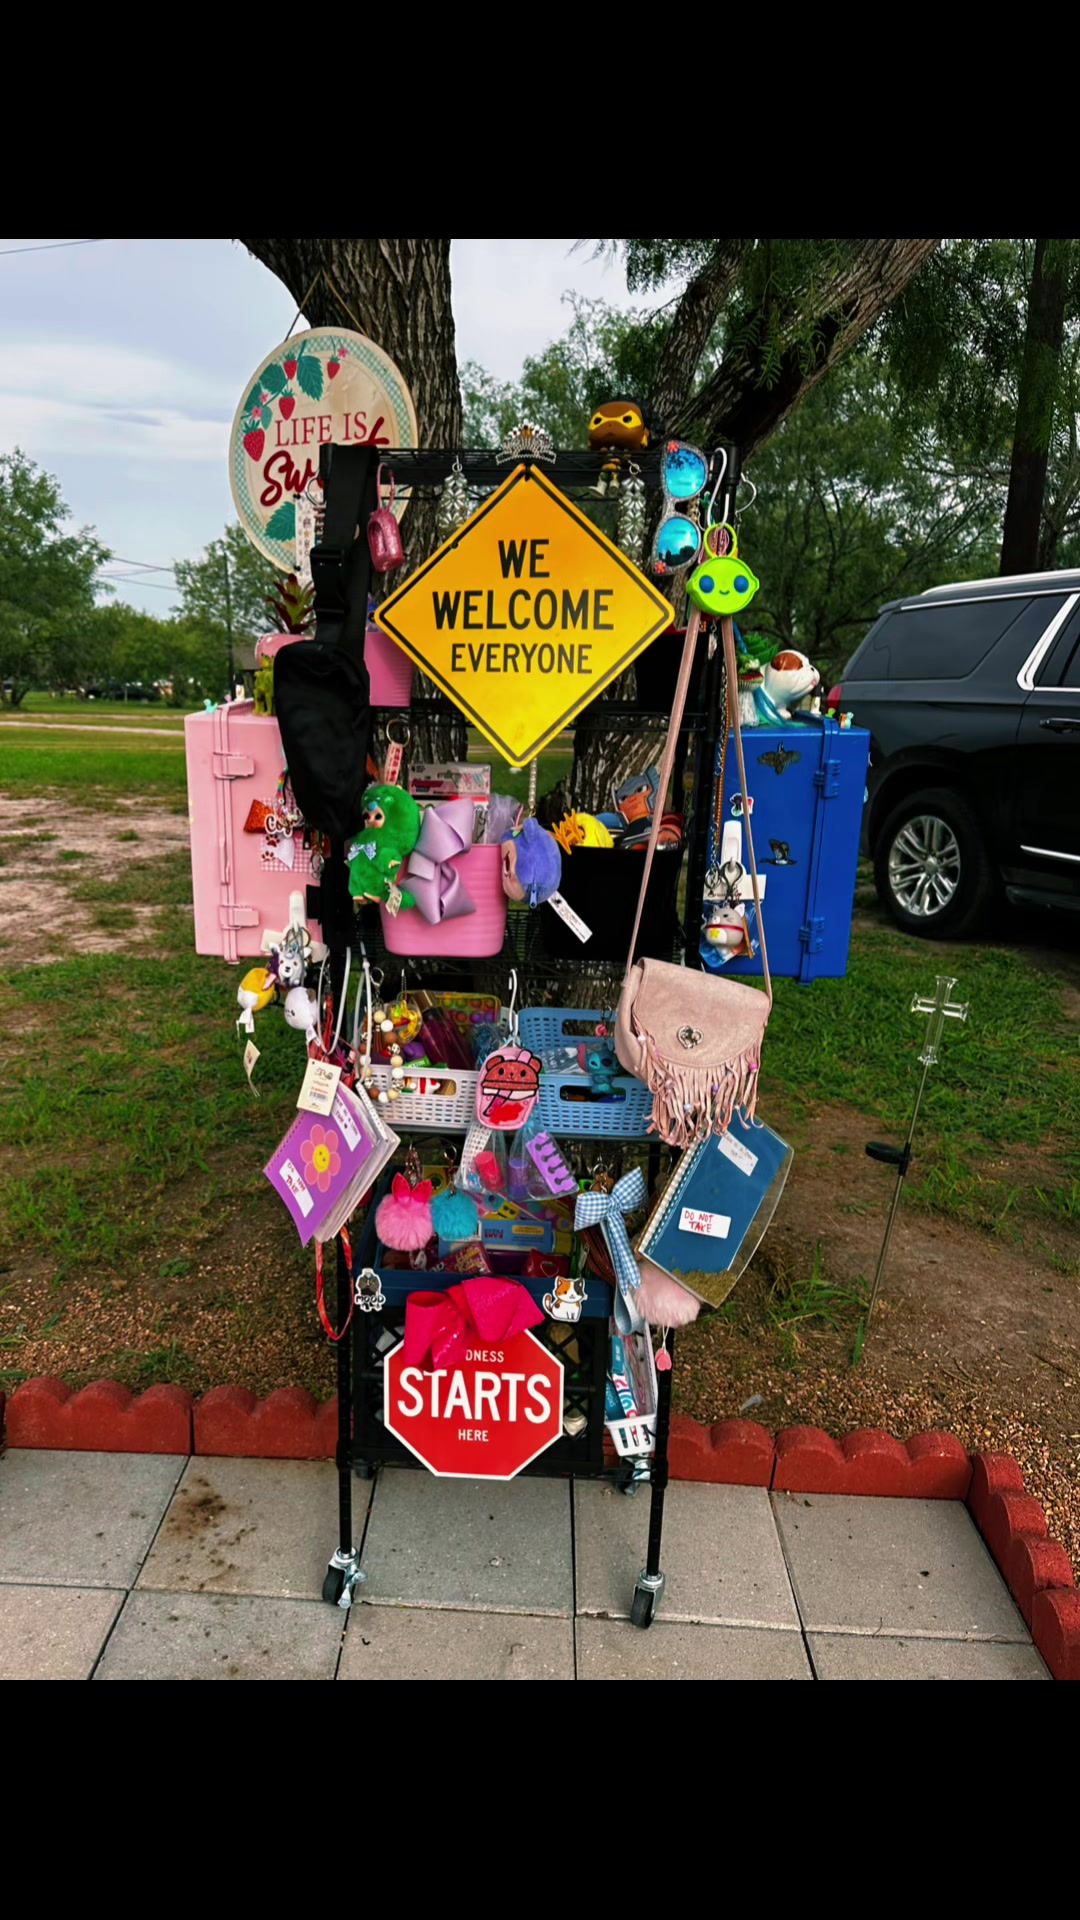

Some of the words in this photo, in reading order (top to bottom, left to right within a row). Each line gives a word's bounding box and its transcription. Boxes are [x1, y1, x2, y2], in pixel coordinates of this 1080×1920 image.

[275, 415, 332, 447] LIFE
[342, 411, 368, 441] IS
[498, 539, 550, 579] WE
[432, 588, 614, 631] WELCOME
[451, 643, 593, 674] EVERYONE
[684, 1210, 695, 1221] DO
[698, 1212, 715, 1222] NOT
[688, 1220, 712, 1233] TAKE
[356, 1295, 384, 1303] MOOD
[465, 1349, 505, 1363] DNESS
[397, 1366, 552, 1424] STARTS
[458, 1428, 489, 1442] HERE
